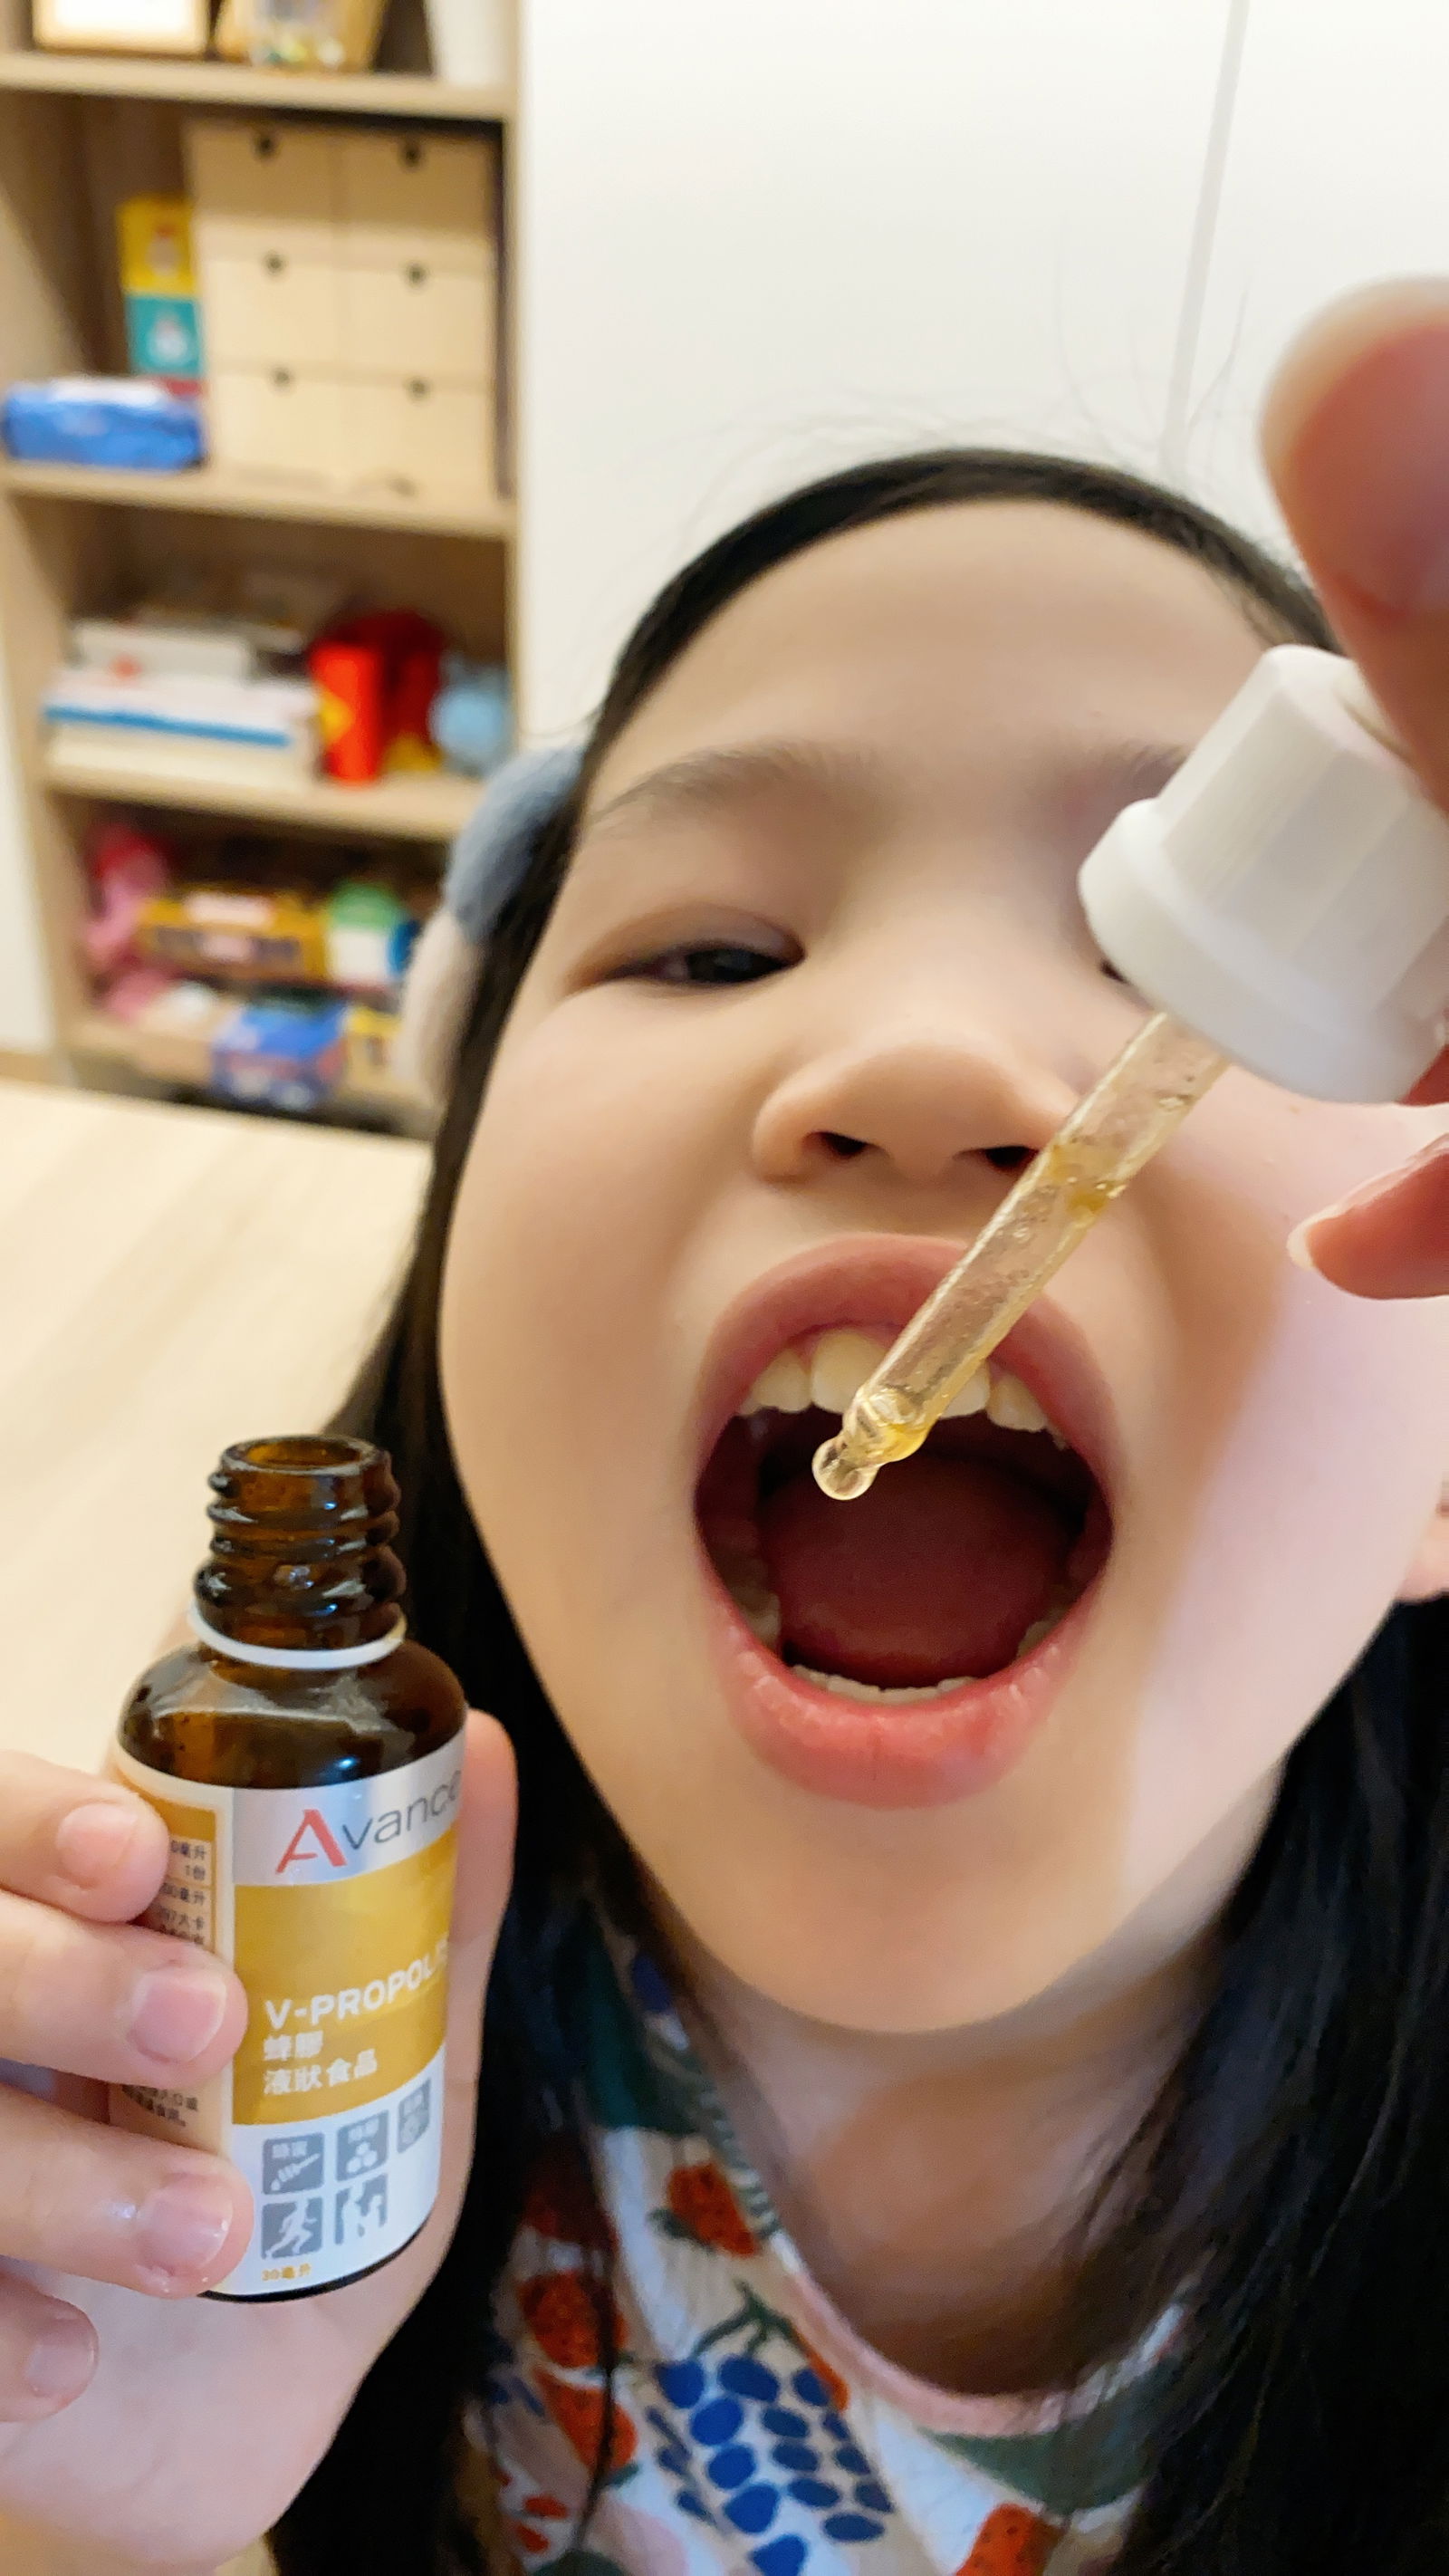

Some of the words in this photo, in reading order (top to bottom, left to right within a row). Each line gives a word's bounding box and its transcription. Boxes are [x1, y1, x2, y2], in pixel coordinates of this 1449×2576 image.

[263, 2030, 323, 2062] 蜂膠
[263, 2048, 378, 2095] 液狀食品
